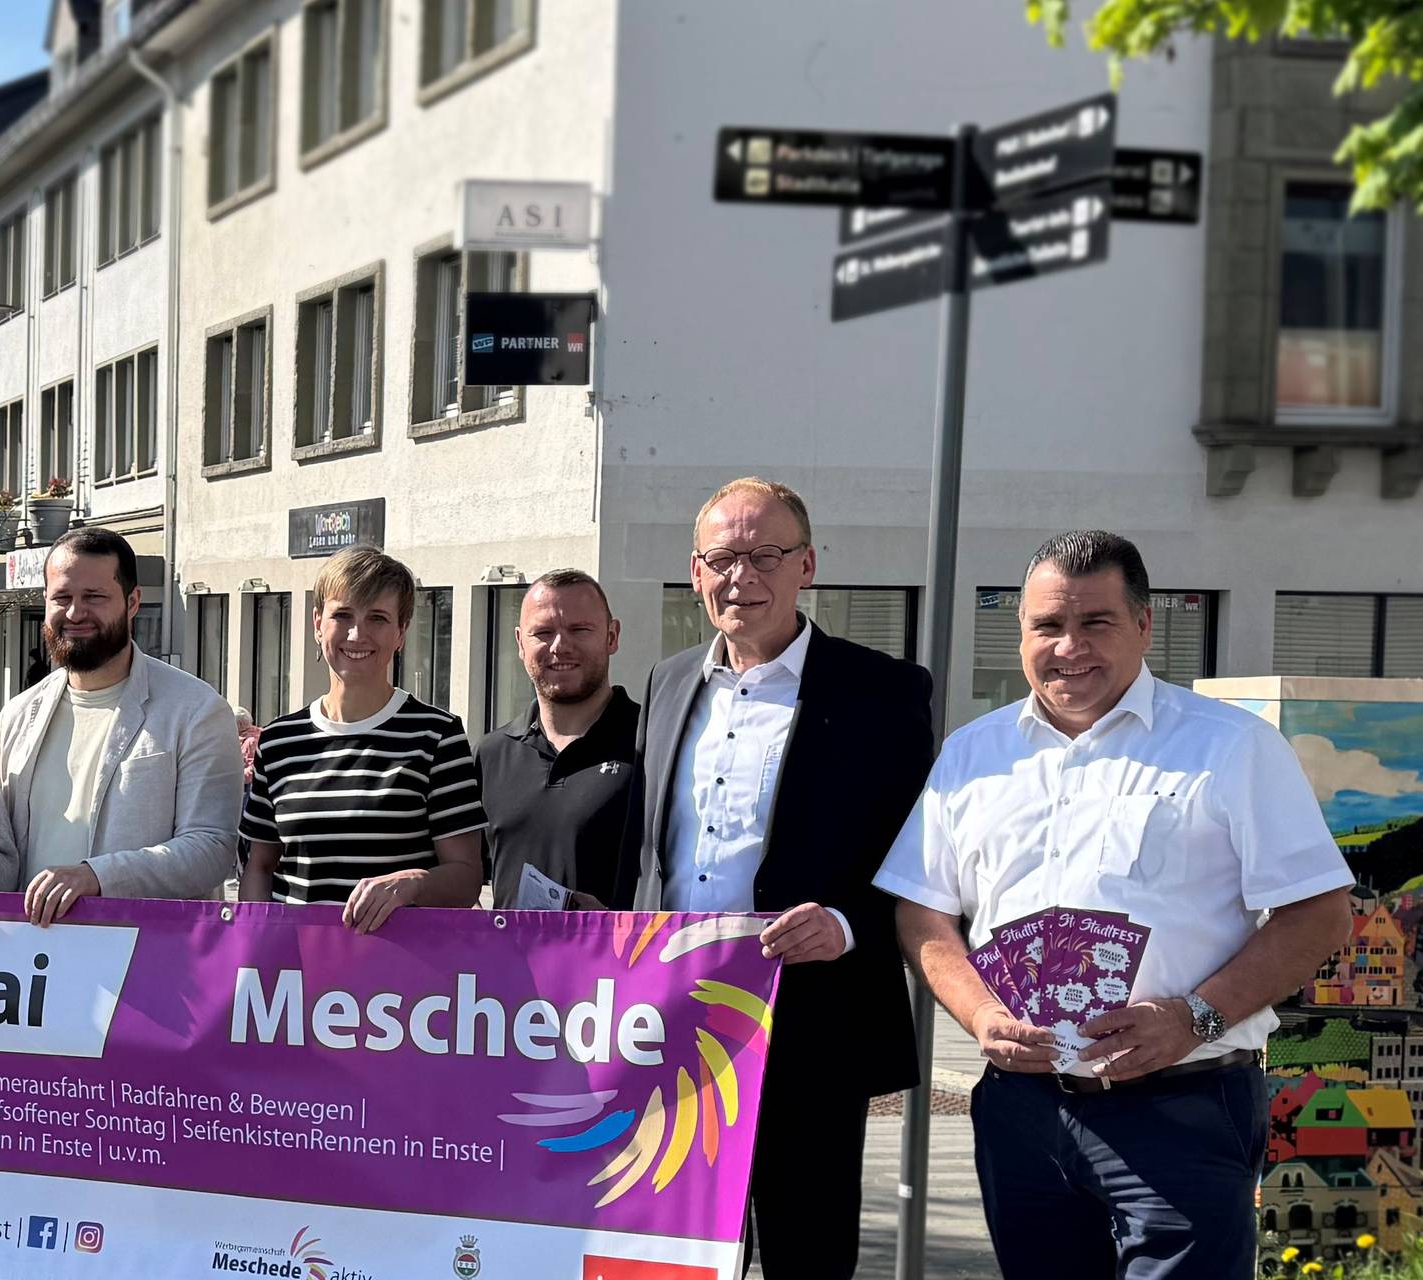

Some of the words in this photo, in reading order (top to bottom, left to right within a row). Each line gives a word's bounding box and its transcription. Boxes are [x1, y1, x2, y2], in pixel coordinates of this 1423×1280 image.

[501, 336, 559, 349] PARTNER
[567, 342, 584, 353] WR
[1078, 917, 1144, 945] StadtFEST
[230, 967, 666, 1066] Meschede
[121, 1083, 222, 1112] Radfahren
[228, 1092, 244, 1114] &
[250, 1093, 353, 1125] Bewegen
[18, 1132, 35, 1152] in
[41, 1133, 93, 1158] Enste
[108, 1144, 167, 1165] u.v.m.
[85, 1108, 166, 1141] Sonntag
[182, 1118, 395, 1156] SeifenkistenRennen
[404, 1135, 424, 1157] in
[432, 1137, 493, 1163] Enste
[212, 1252, 302, 1279] Meschede
